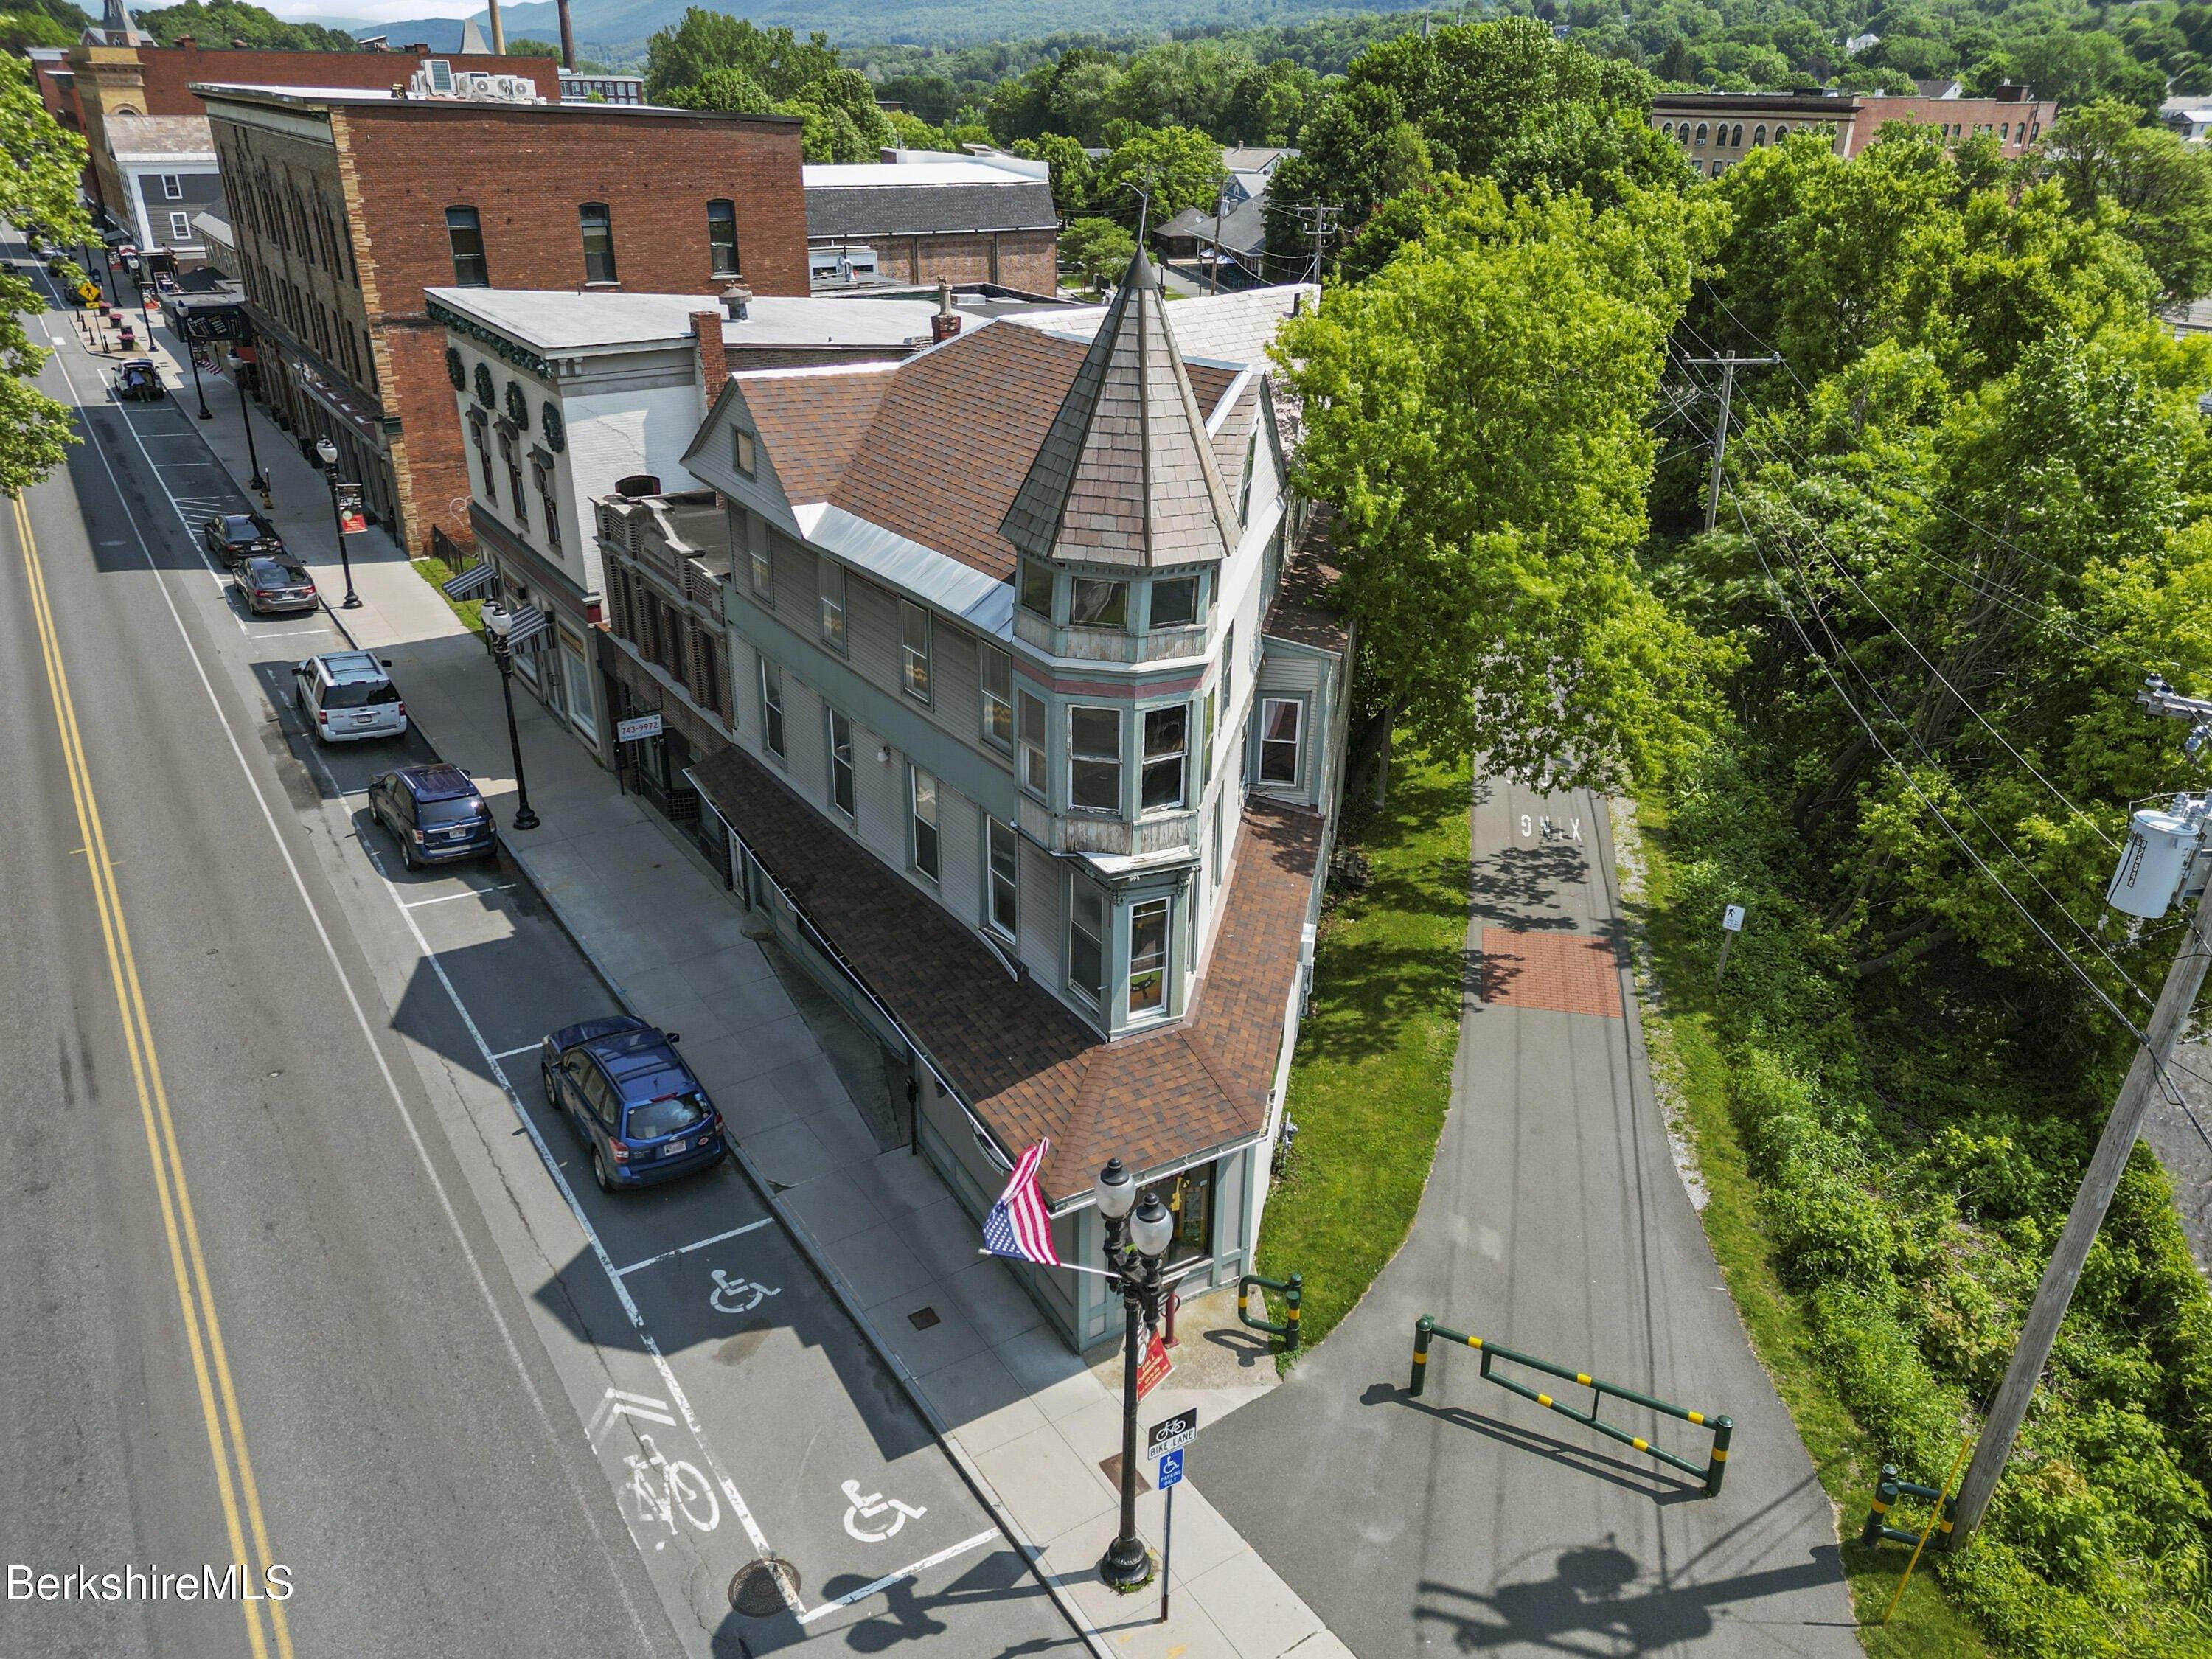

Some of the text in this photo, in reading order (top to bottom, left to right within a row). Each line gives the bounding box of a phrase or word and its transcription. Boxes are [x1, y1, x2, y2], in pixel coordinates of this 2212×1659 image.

[622, 722, 658, 734] 743-9972
[1150, 1430, 1193, 1457] BIKE LANE
[1160, 1469, 1181, 1483] PARKING
[1164, 1476, 1177, 1486] ONLY
